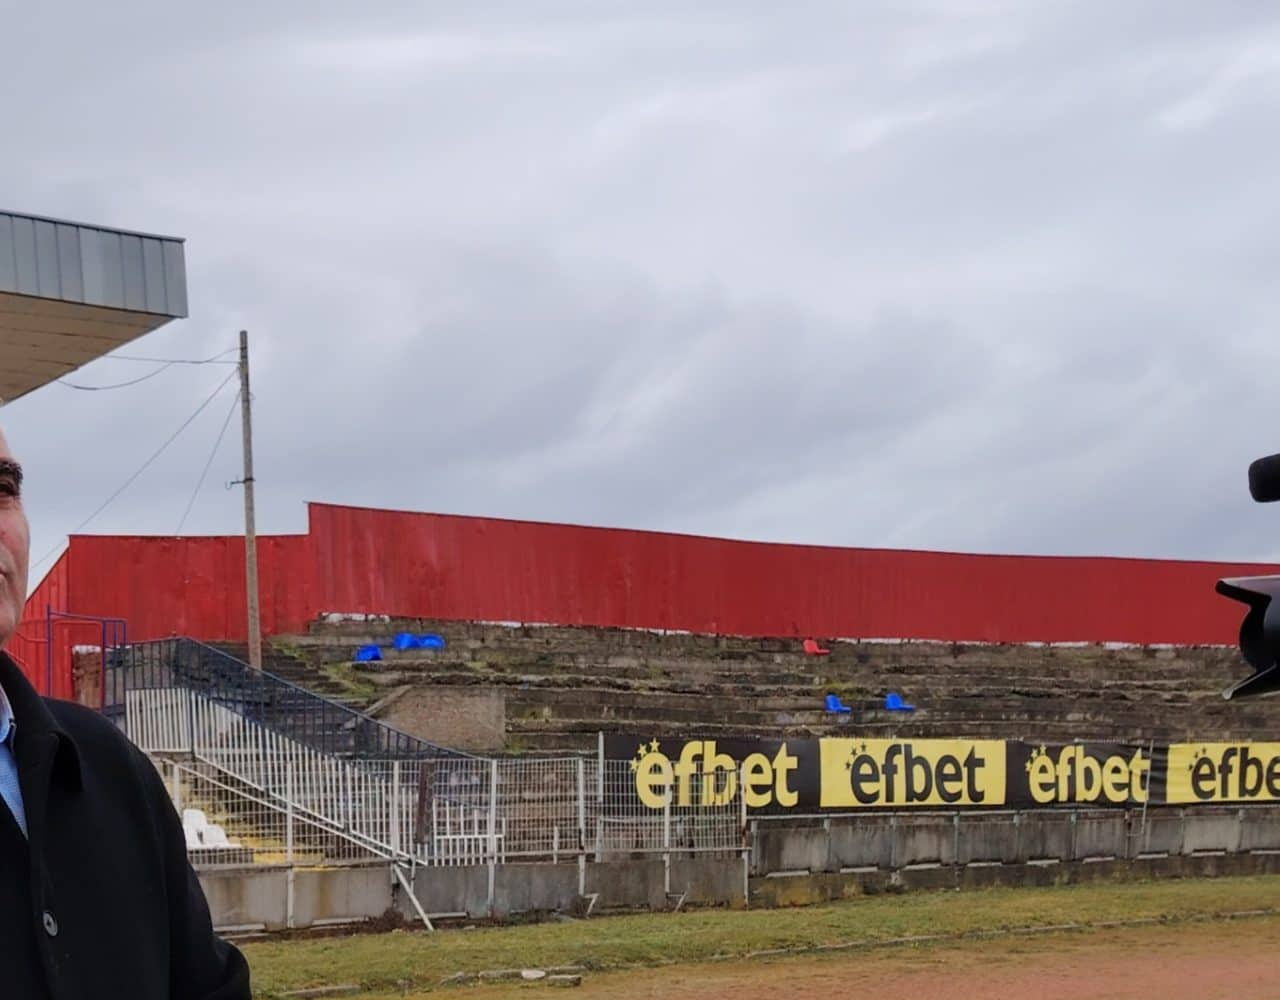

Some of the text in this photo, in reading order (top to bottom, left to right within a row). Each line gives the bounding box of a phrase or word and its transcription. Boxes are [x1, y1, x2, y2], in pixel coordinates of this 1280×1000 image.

[636, 740, 799, 809] efbet
[850, 743, 985, 804] efbet
[1028, 744, 1152, 804] efbet
[1190, 746, 1280, 800] efbe
